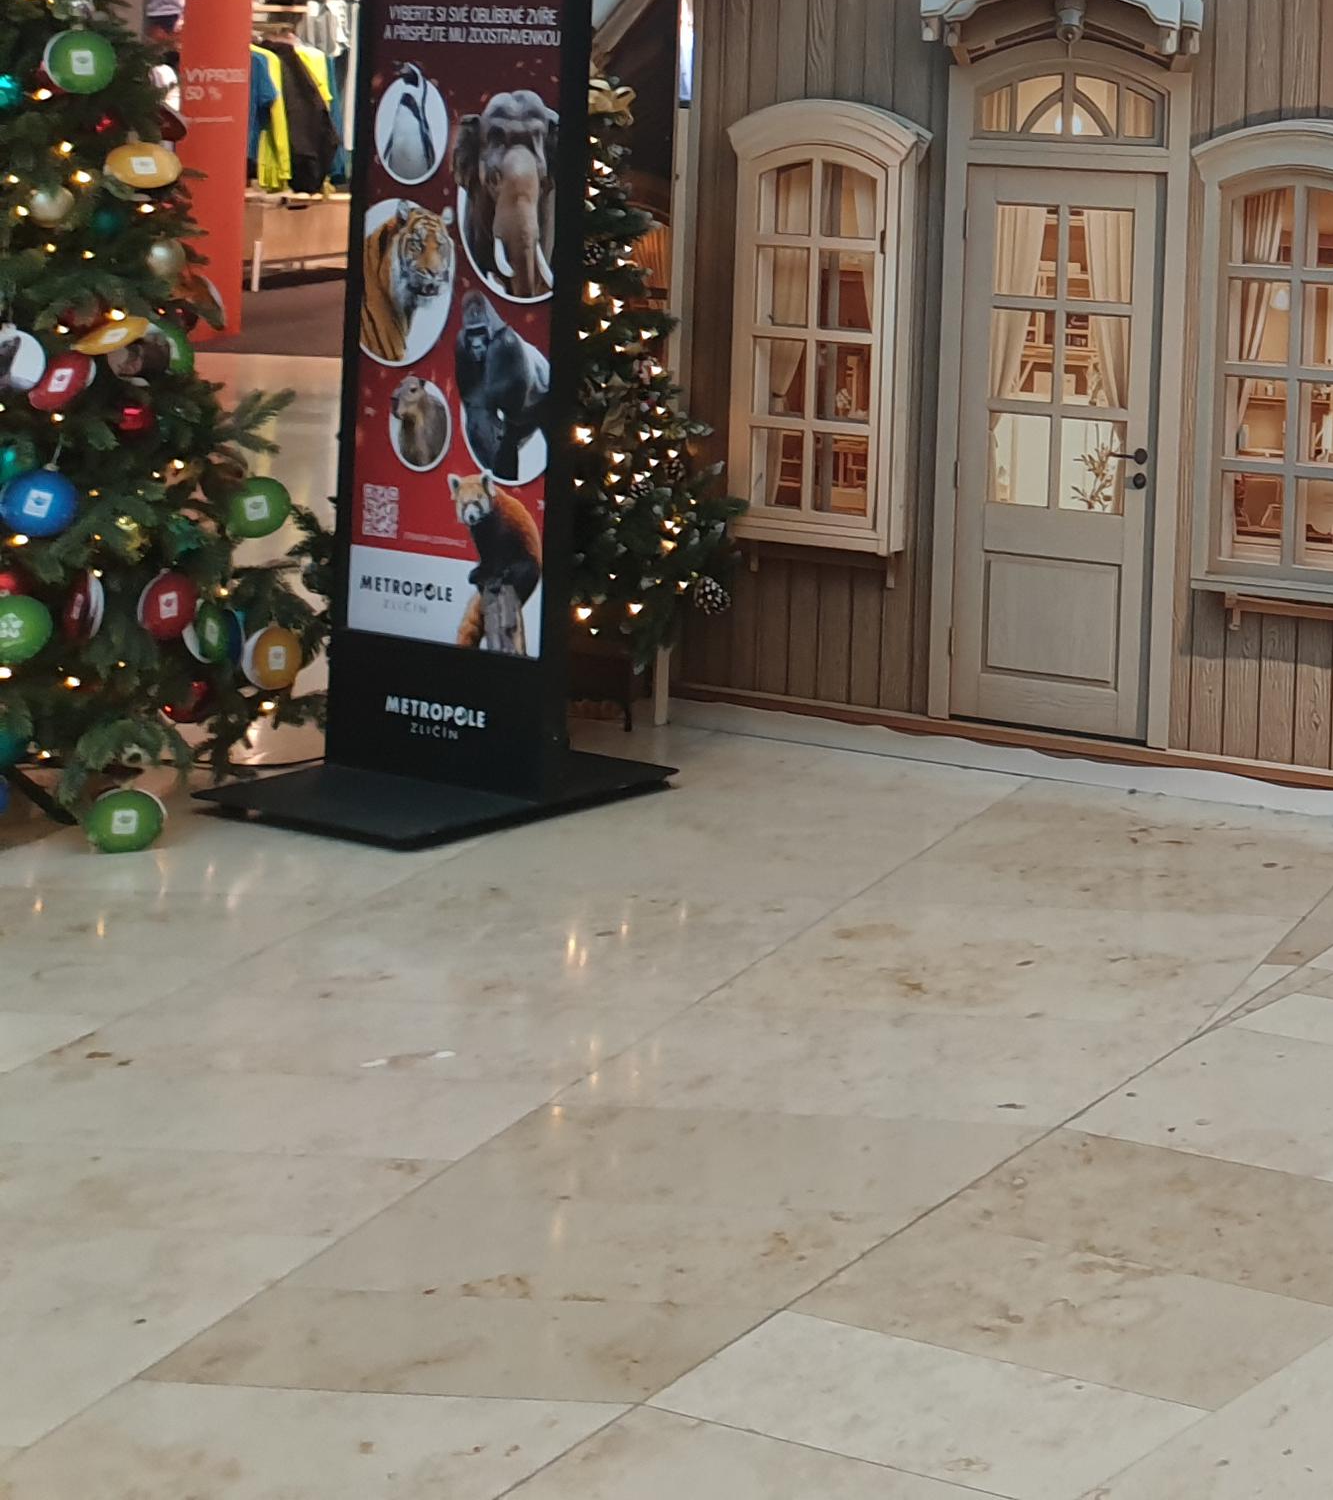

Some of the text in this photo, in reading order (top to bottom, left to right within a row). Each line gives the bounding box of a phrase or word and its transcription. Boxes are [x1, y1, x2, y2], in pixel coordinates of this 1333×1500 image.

[389, 5, 558, 25] VYBERTE SI SVÉ OBLÍBENÉ ZVÍŘE
[384, 25, 392, 39] A
[448, 26, 467, 42] MU
[468, 27, 561, 46] ZOOSTRAVENKOU
[360, 575, 453, 602] METROPOLE
[385, 695, 486, 728] METROPOLE
